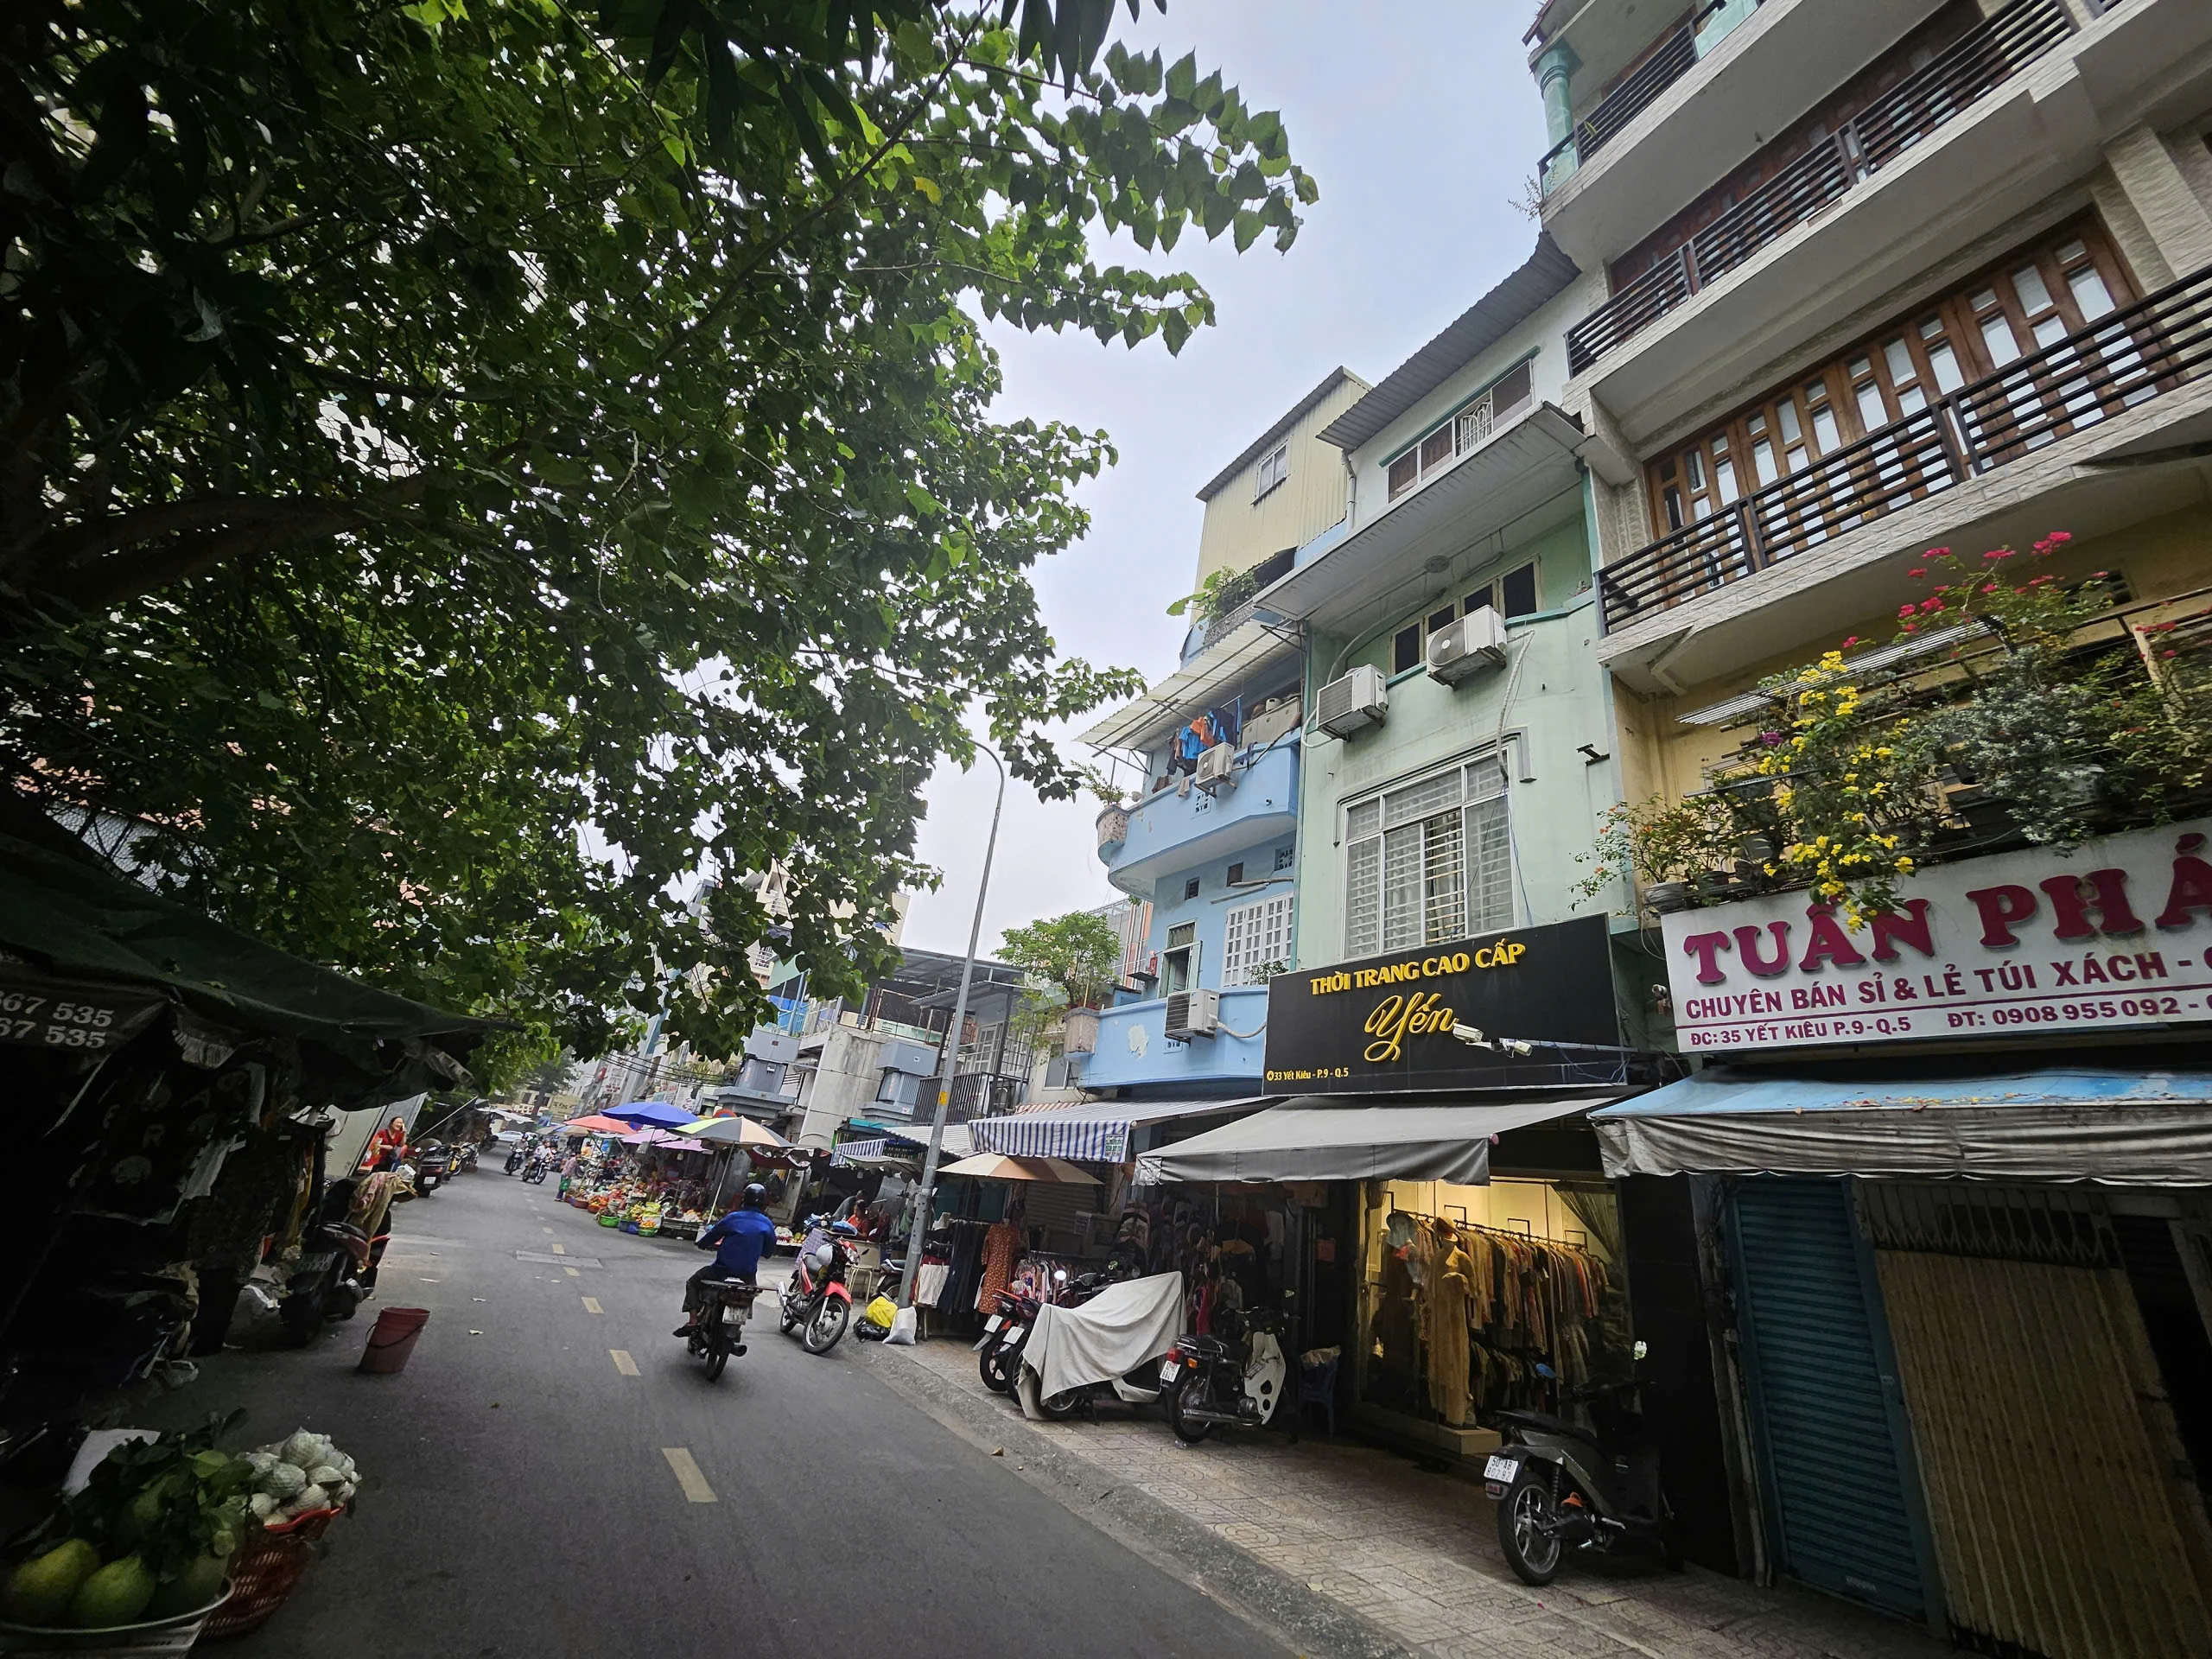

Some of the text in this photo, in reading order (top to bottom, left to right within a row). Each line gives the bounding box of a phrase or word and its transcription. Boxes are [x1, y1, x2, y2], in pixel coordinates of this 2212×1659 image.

[1310, 938, 1526, 995] THỜI TRANG CAO CẤP
[1686, 988, 1783, 1019] CHUYÊN
[1790, 981, 1847, 1009] BÁN
[1858, 972, 1886, 1004] SỈ
[1893, 977, 1918, 1001] &
[1923, 963, 1967, 998] LẺ
[1973, 959, 2037, 993] TÚI
[2050, 951, 2169, 987] XÁCH
[0, 990, 115, 1027] 67 535
[1363, 991, 1459, 1062] Yến
[1691, 1032, 1718, 1046] ĐC:
[1721, 1029, 1741, 1044] 35
[1745, 1021, 1779, 1042] YẾT
[1784, 1020, 1827, 1039] KIÊU
[1948, 1011, 1986, 1028] ĐT:
[1992, 1006, 2058, 1025] 0908
[2062, 1001, 2118, 1020] 955
[2120, 996, 2183, 1017] 092
[44, 1025, 107, 1049] 535
[1274, 1071, 1282, 1081] 33
[1283, 1070, 1294, 1081] Yết
[1295, 1070, 1312, 1080] Kiêu
[1317, 1068, 1329, 1078] P.9
[1334, 1067, 1349, 1077] Q.5
